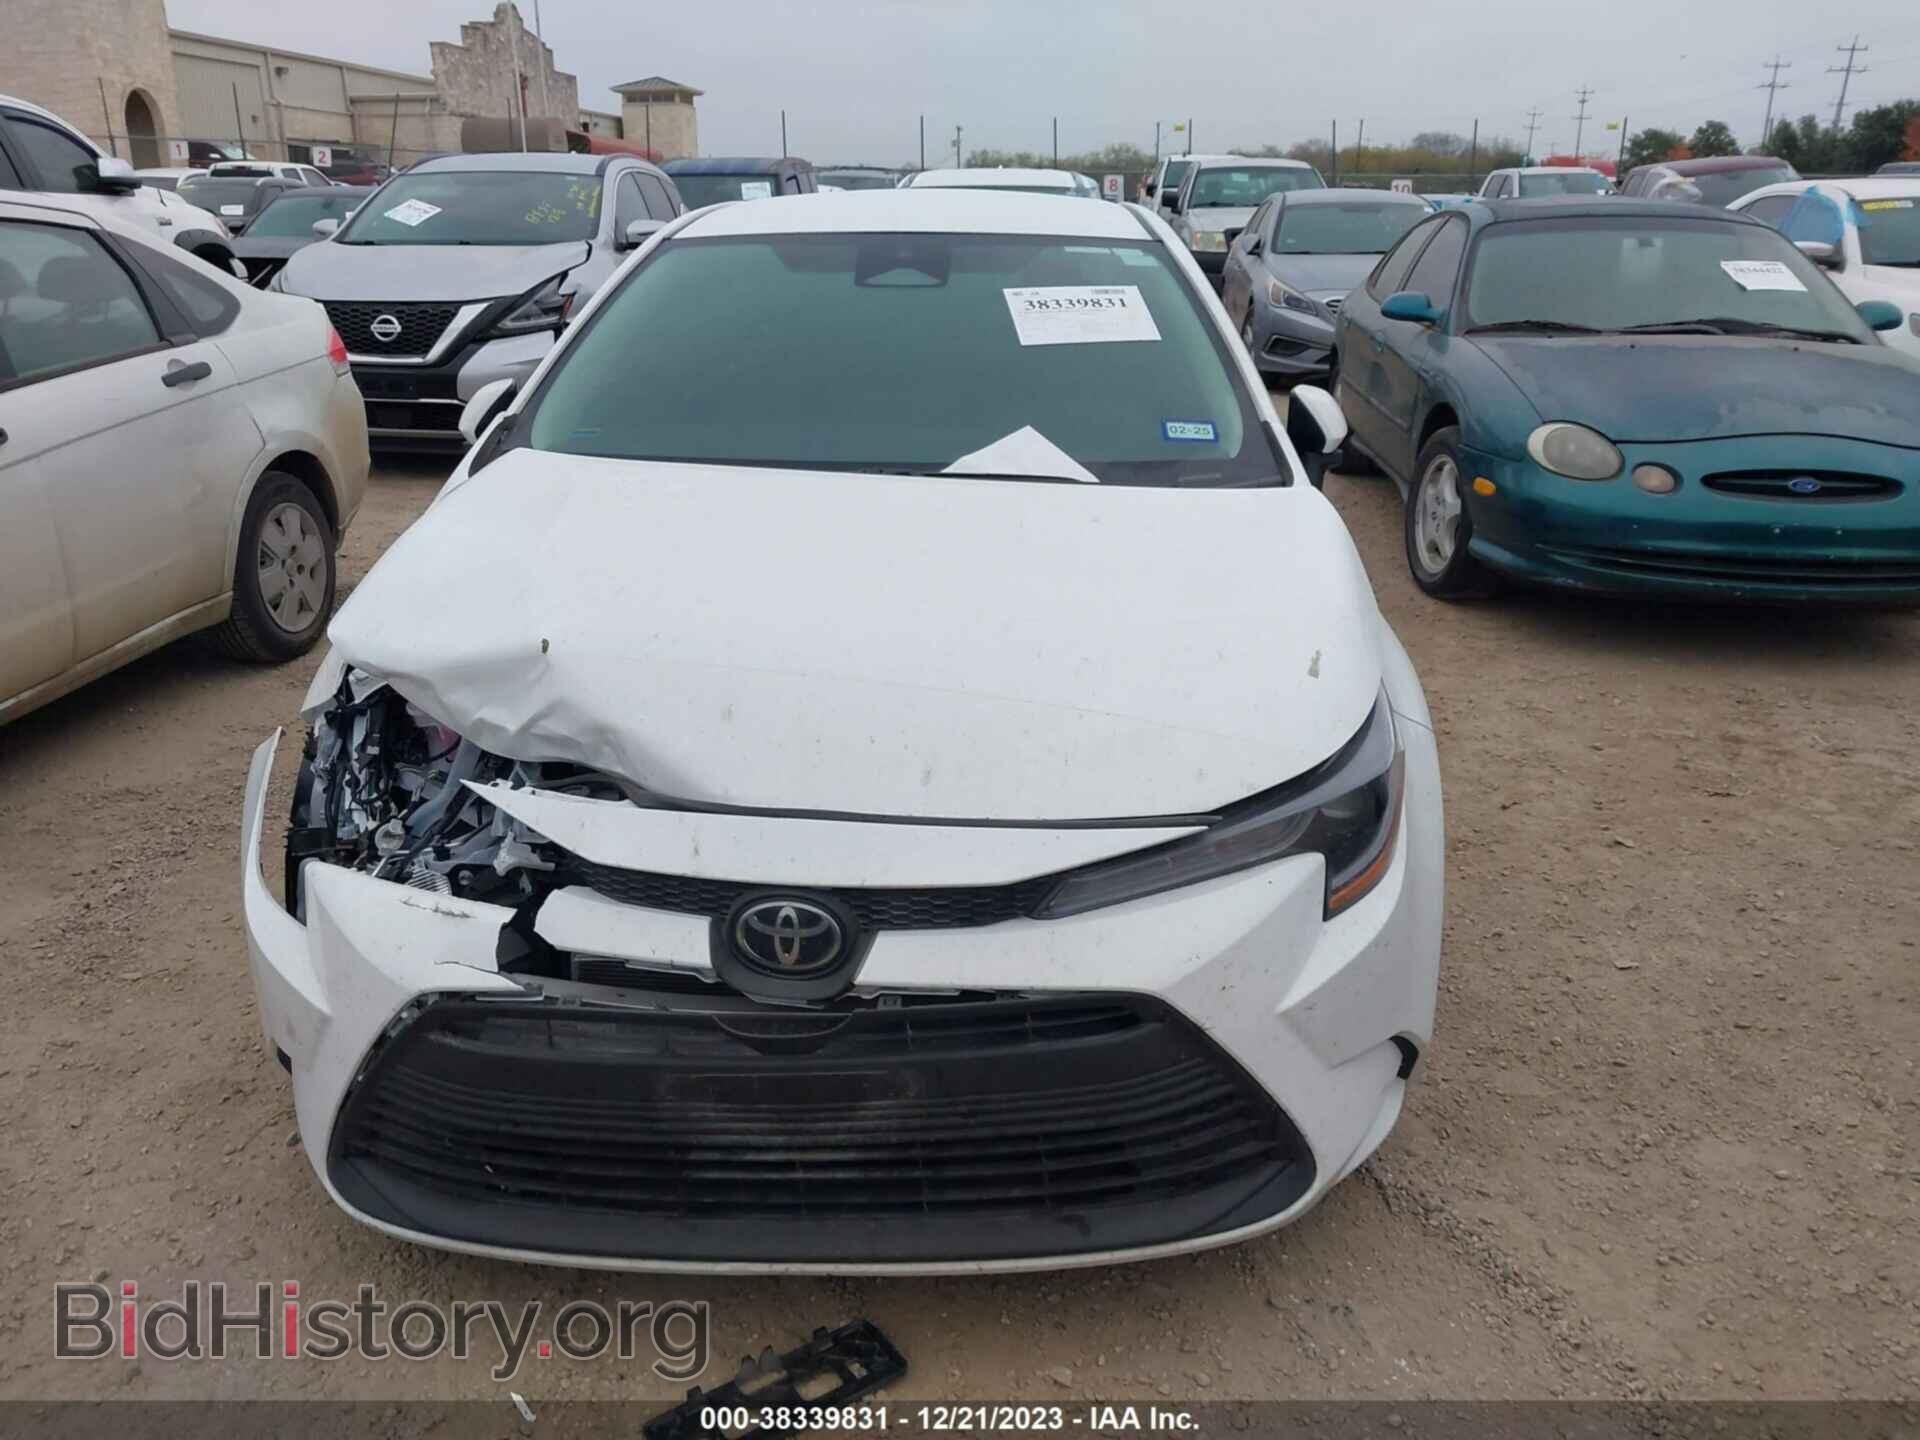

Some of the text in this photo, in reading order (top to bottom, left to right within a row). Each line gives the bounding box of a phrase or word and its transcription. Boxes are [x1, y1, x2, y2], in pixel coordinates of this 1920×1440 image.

[175, 144, 181, 157] 1
[318, 151, 327, 166] 2
[1109, 178, 1118, 192] 8
[1024, 298, 1128, 311] 38339831
[1168, 425, 1210, 436] 02-25
